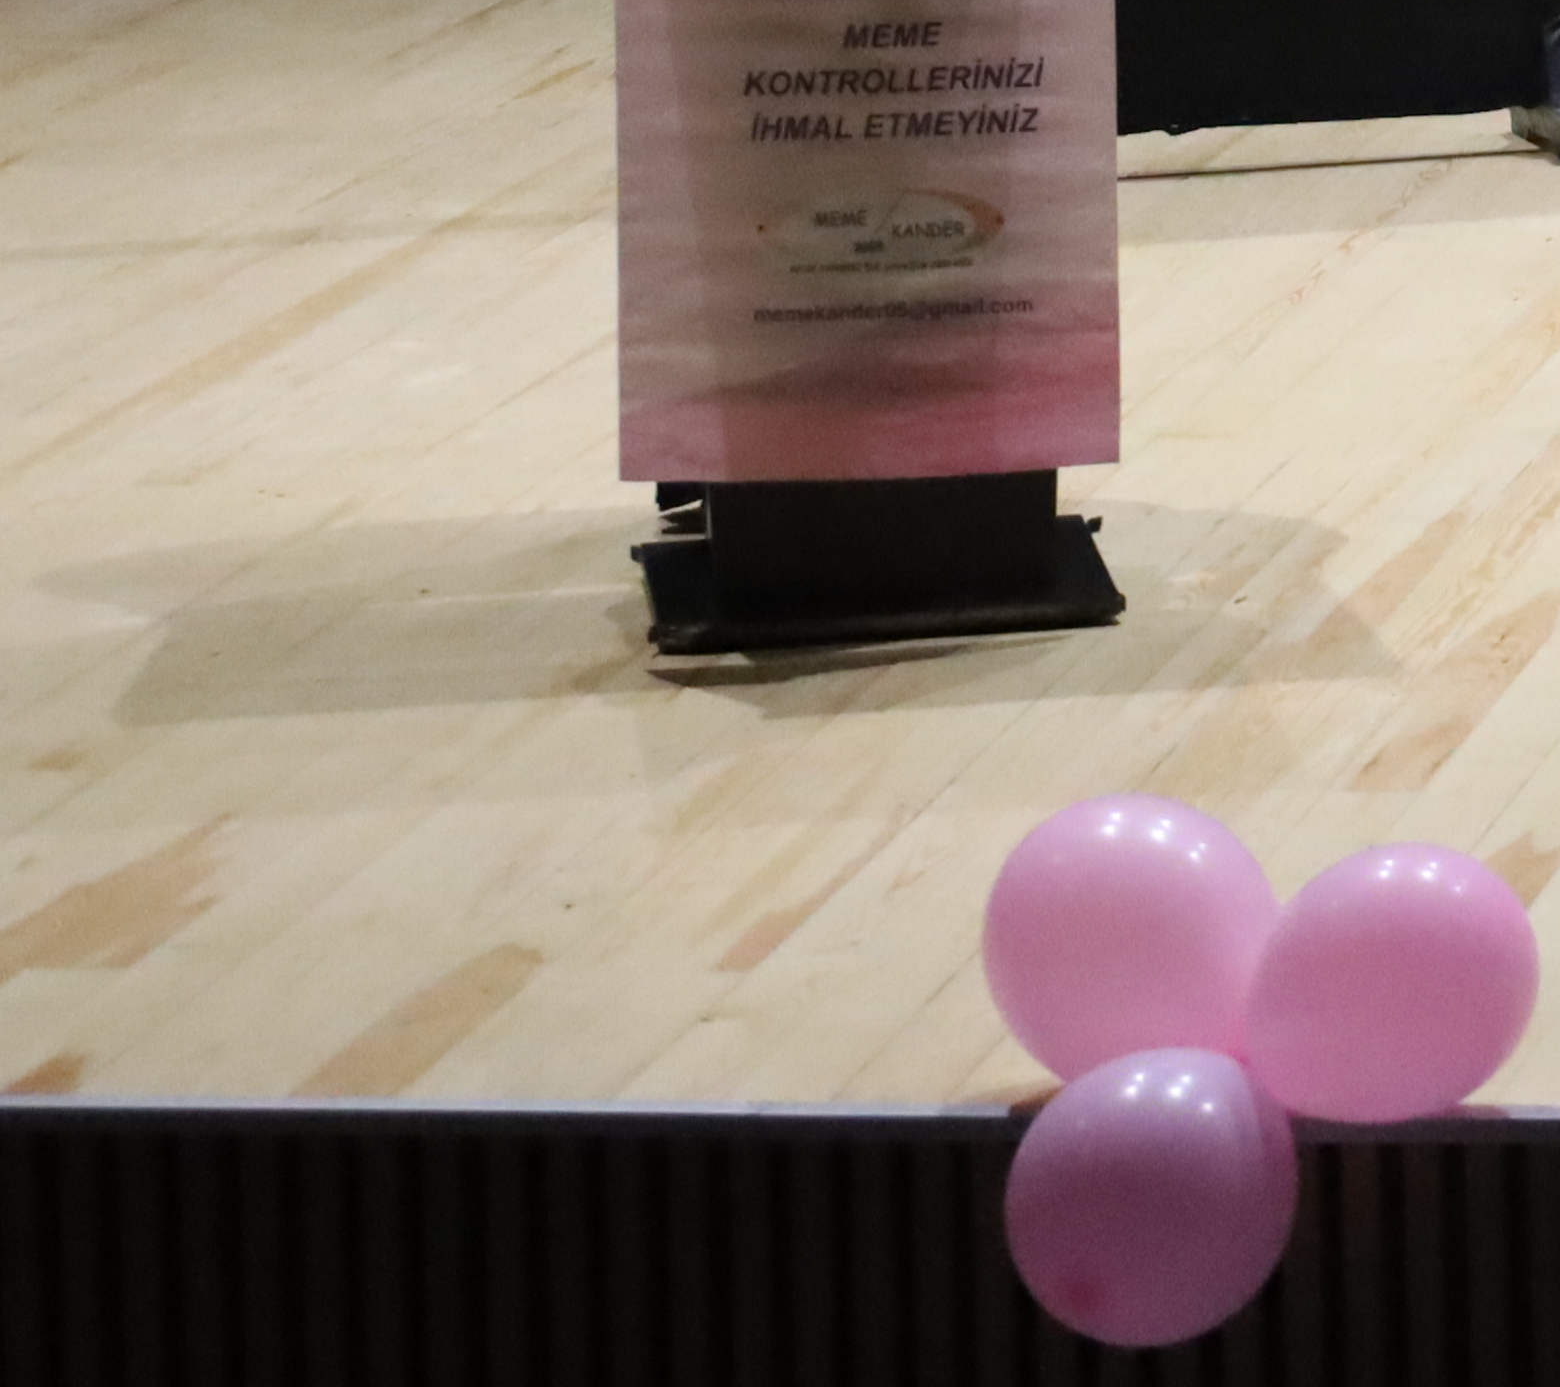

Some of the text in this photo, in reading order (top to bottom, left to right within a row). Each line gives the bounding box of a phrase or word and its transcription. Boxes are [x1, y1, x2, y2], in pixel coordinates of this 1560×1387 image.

[843, 22, 942, 50] MEME
[743, 56, 1045, 98] KONTROLLERİNİZİ
[751, 102, 1039, 143] İHMAL ETMEYİNİZ
[813, 209, 966, 238] MEME KANDER
